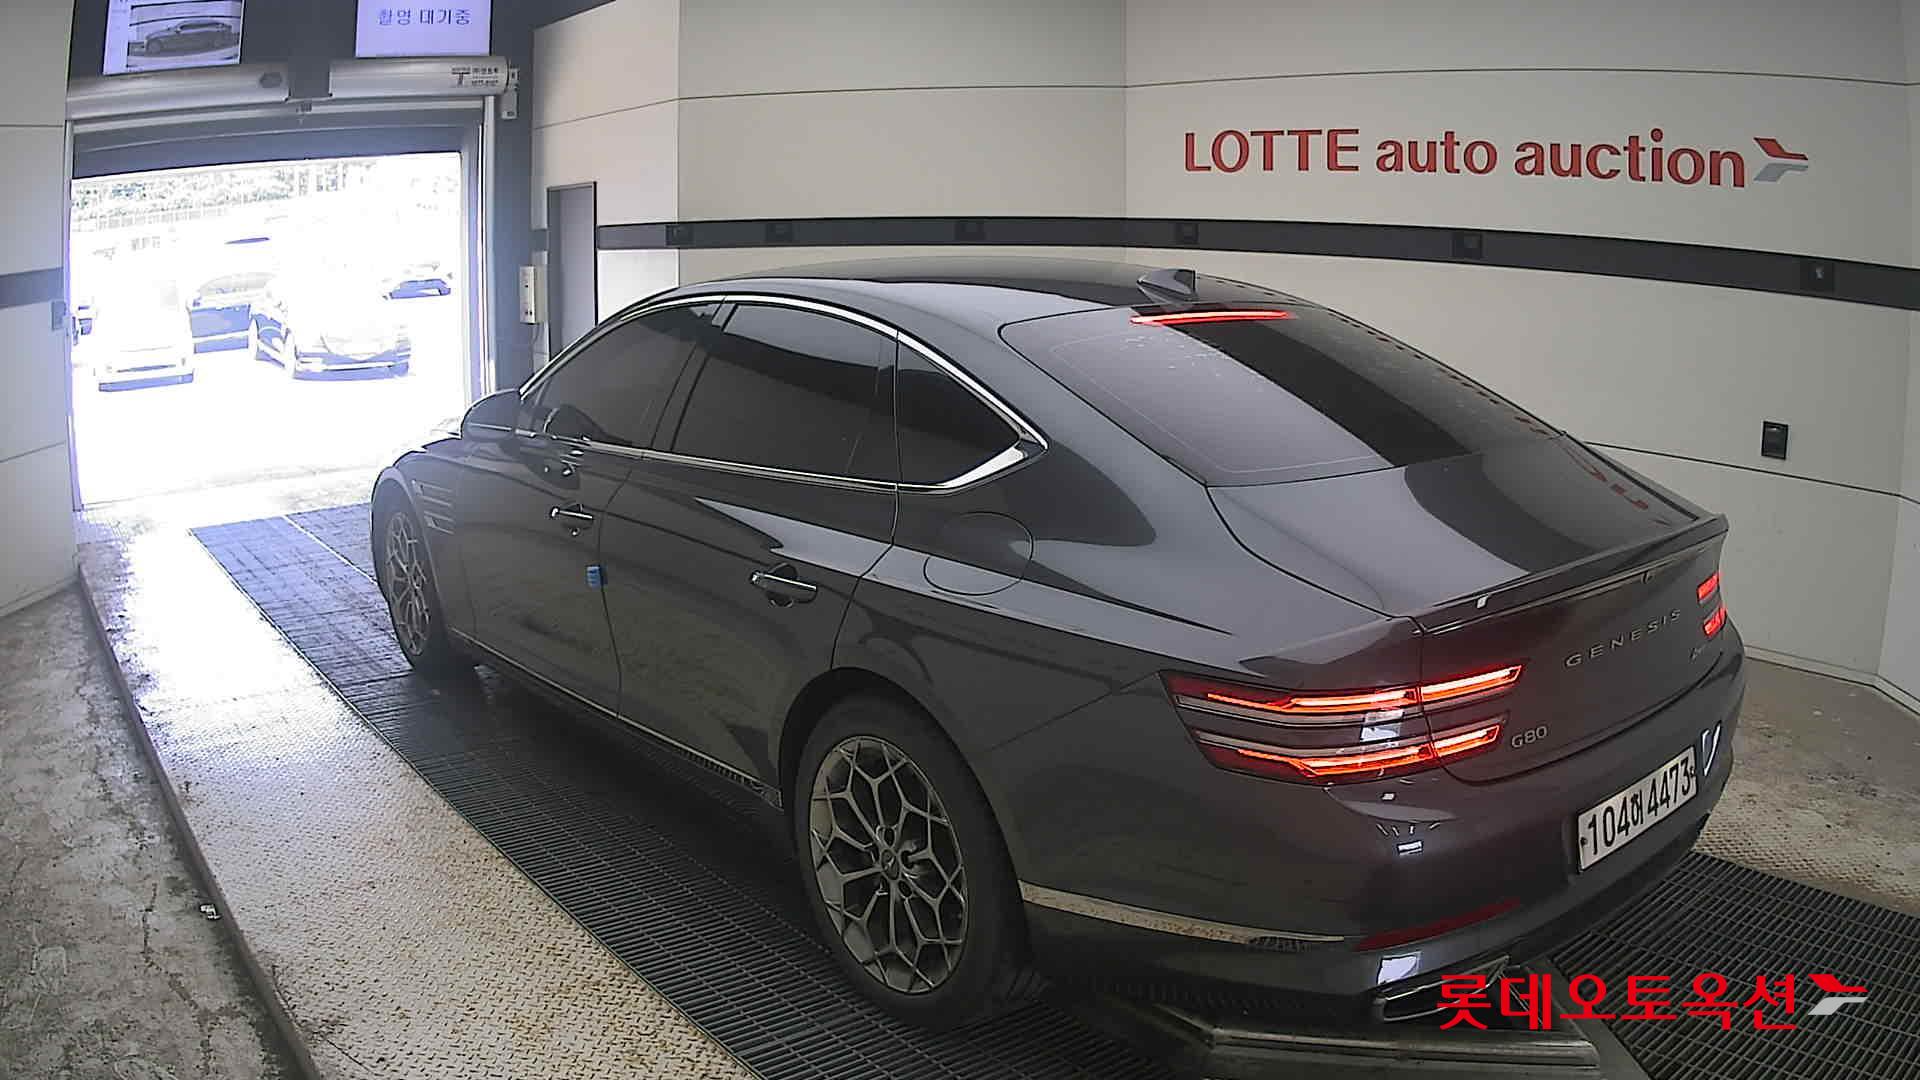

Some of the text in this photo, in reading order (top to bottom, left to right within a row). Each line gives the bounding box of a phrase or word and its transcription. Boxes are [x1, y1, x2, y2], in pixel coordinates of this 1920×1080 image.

[419, 8, 471, 26] 대기중
[1185, 127, 1745, 188] LOTTE auto auction
[1564, 609, 1681, 669] GENESIS
[1510, 725, 1548, 748] G80
